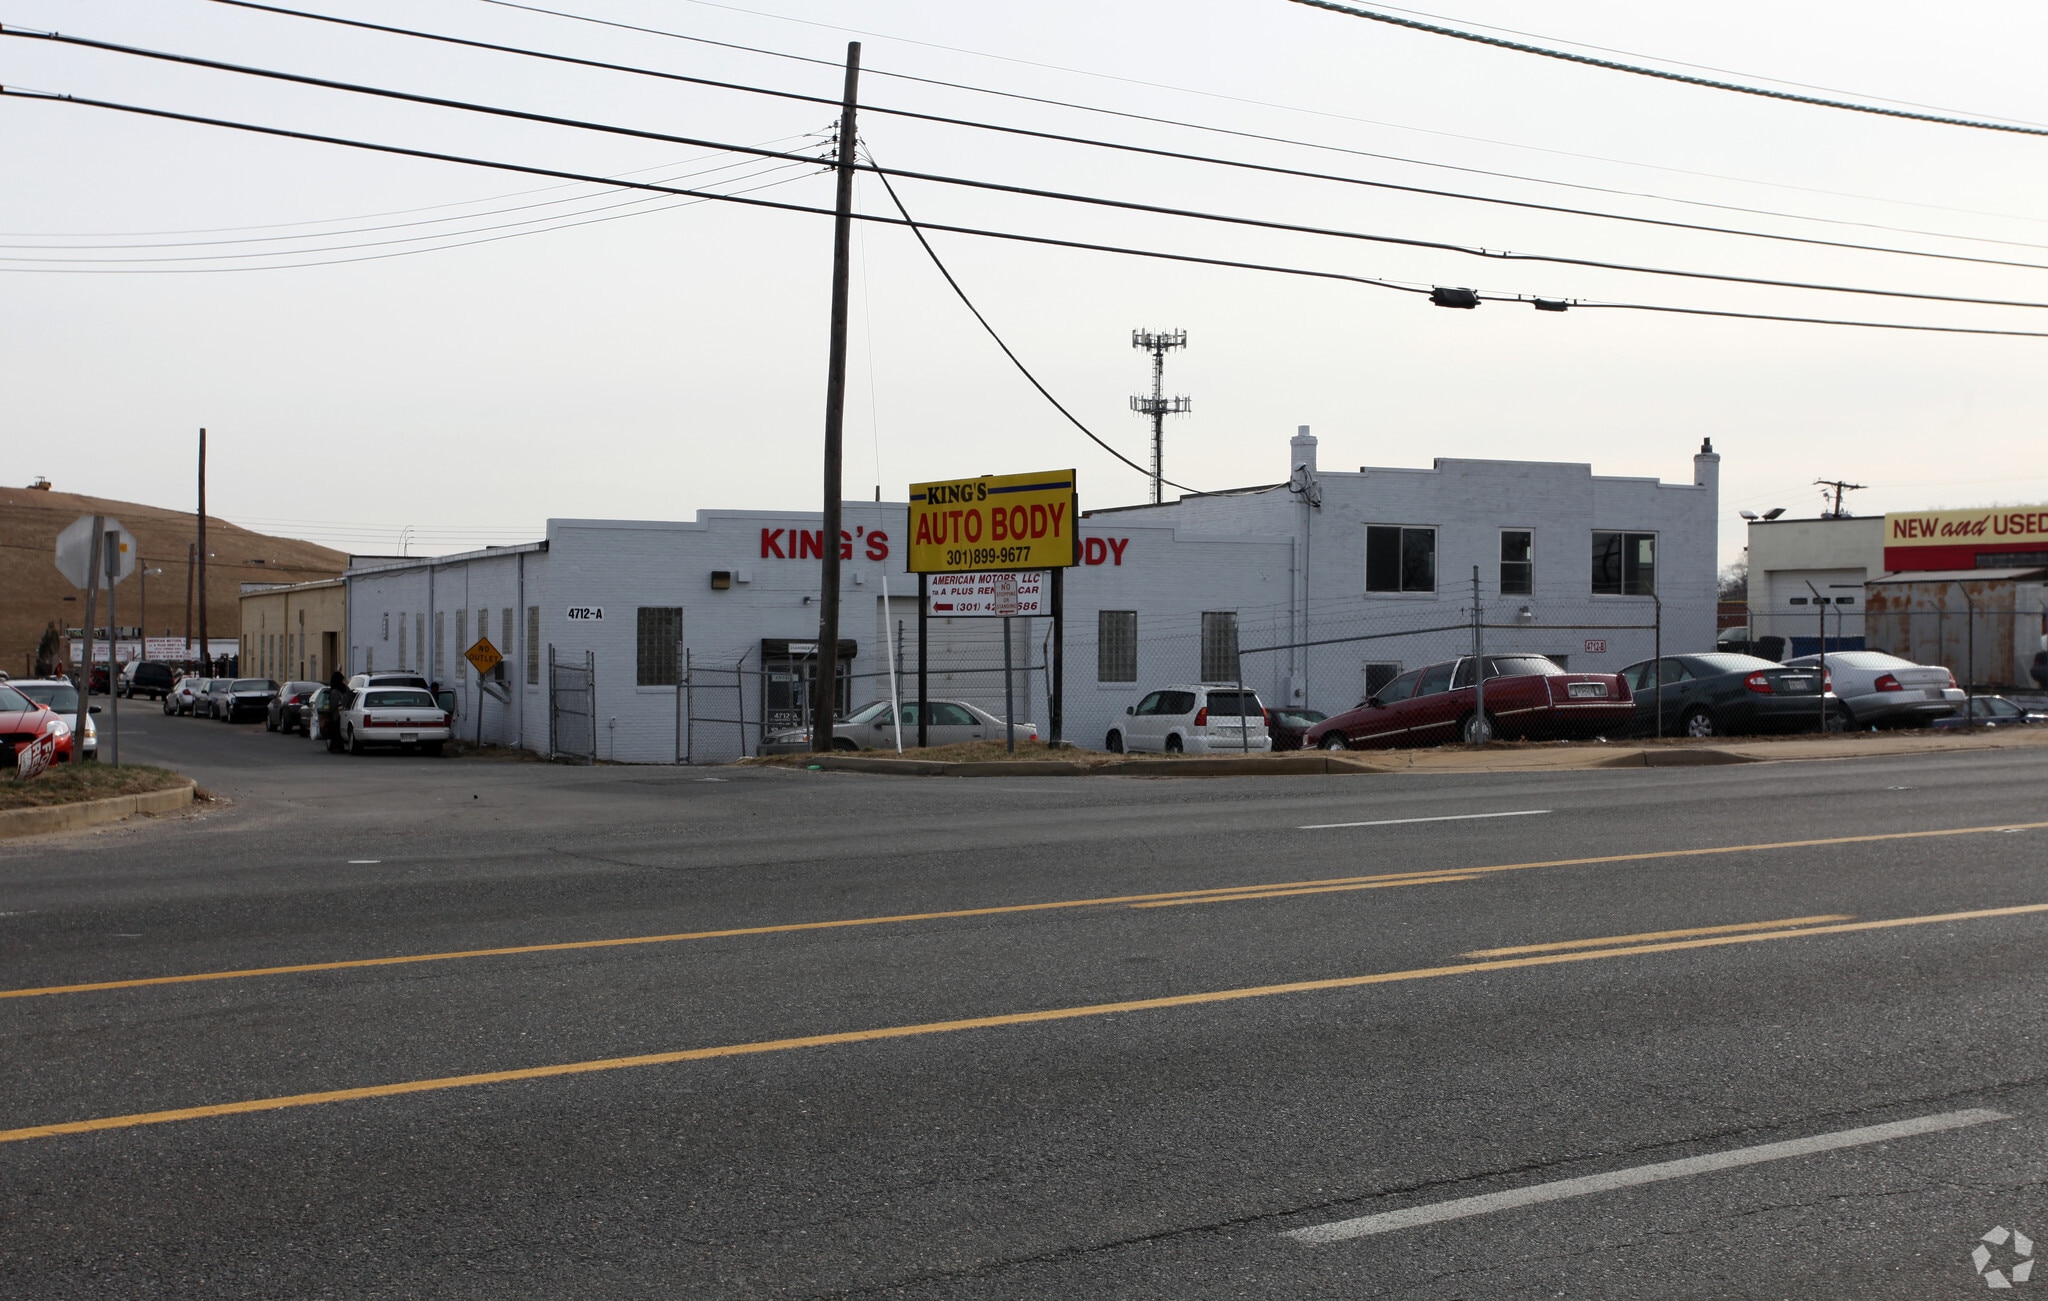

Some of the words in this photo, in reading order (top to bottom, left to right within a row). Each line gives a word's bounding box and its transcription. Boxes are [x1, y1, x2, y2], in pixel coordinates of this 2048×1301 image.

[927, 482, 987, 505] KING'S
[915, 508, 983, 546] AUTO
[991, 502, 1066, 541] BODY
[1893, 517, 1939, 539] NEW
[1940, 514, 1991, 537] and
[1993, 512, 2048, 535] USED
[946, 545, 1031, 568] 301)899-9677
[932, 575, 975, 585] AMERICAN
[1022, 573, 1040, 583] LLC
[951, 587, 974, 595] PLUS
[977, 586, 995, 594] REN
[1018, 586, 1040, 594] CAR
[956, 602, 981, 611] (301)
[568, 608, 603, 619] 4712-A
[469, 653, 499, 663] OUTLET
